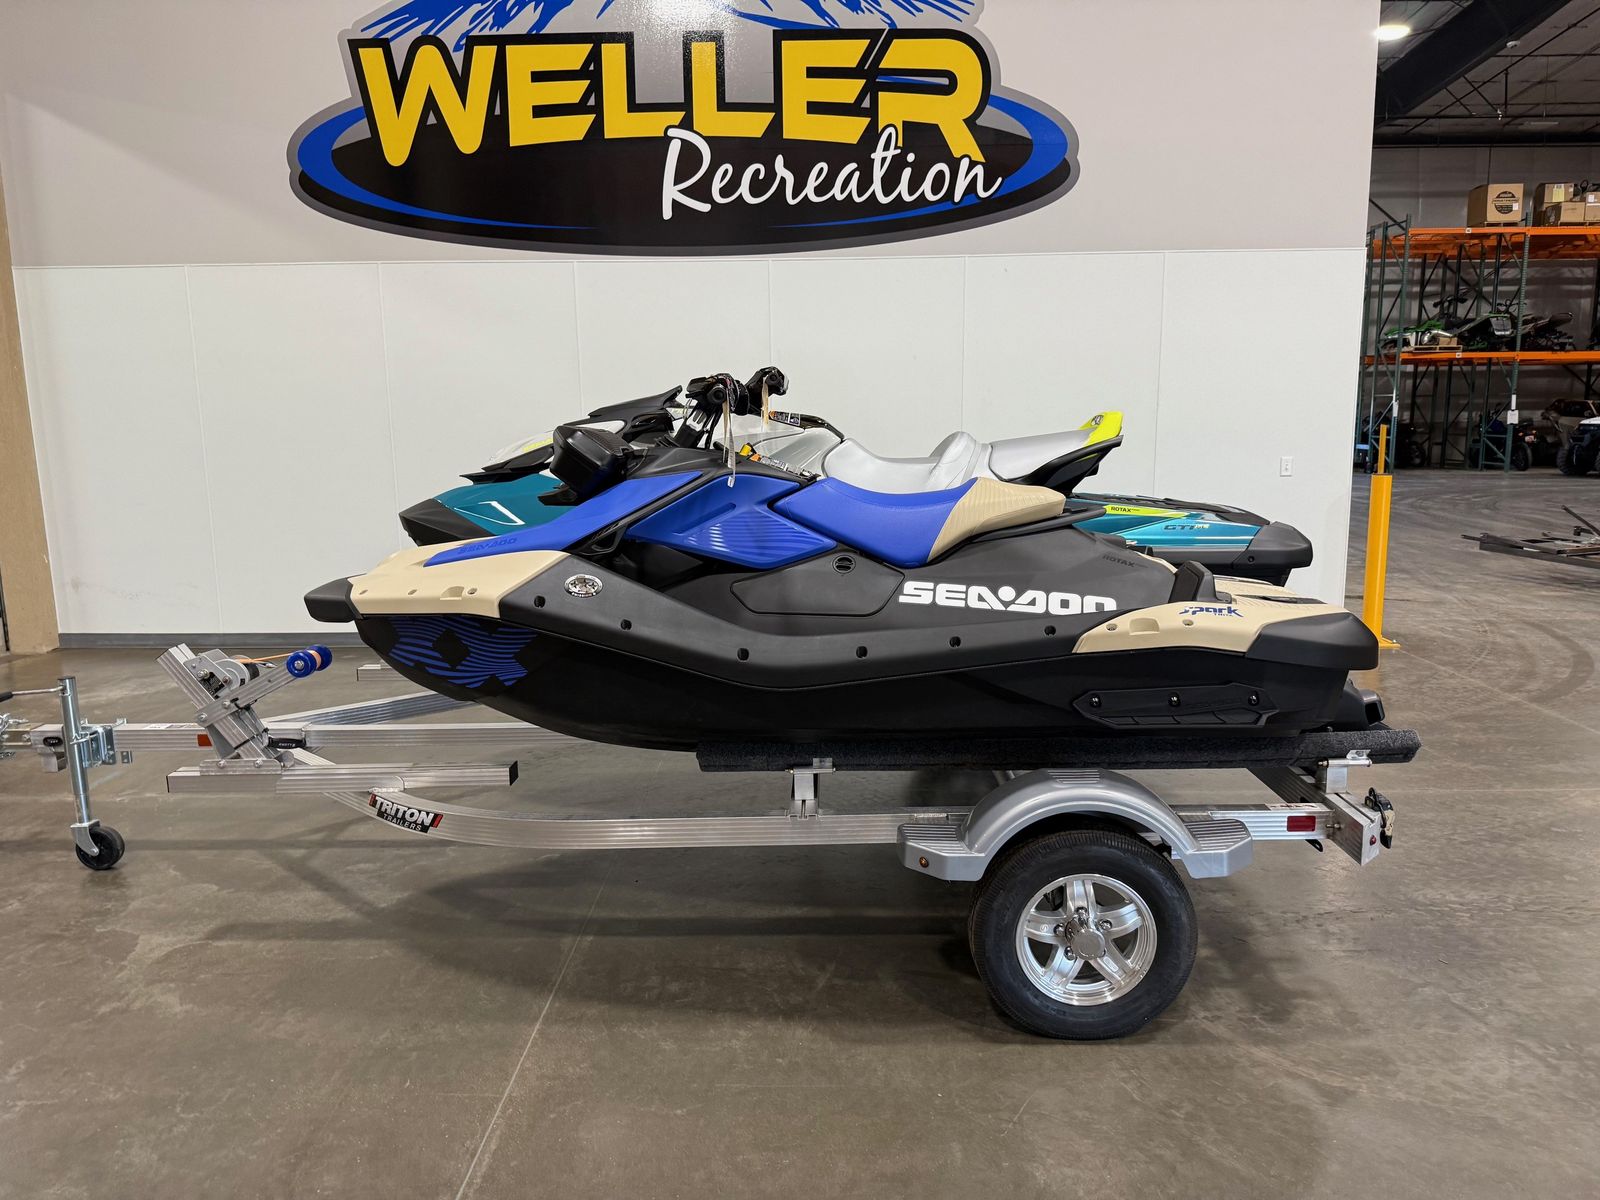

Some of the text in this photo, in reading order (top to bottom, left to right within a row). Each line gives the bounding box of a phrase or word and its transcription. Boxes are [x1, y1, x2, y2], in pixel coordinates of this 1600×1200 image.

[357, 39, 986, 167] WELLER
[661, 126, 1003, 221] Recreation
[375, 797, 434, 826] TRITON
[383, 814, 422, 831] TRAILERS
